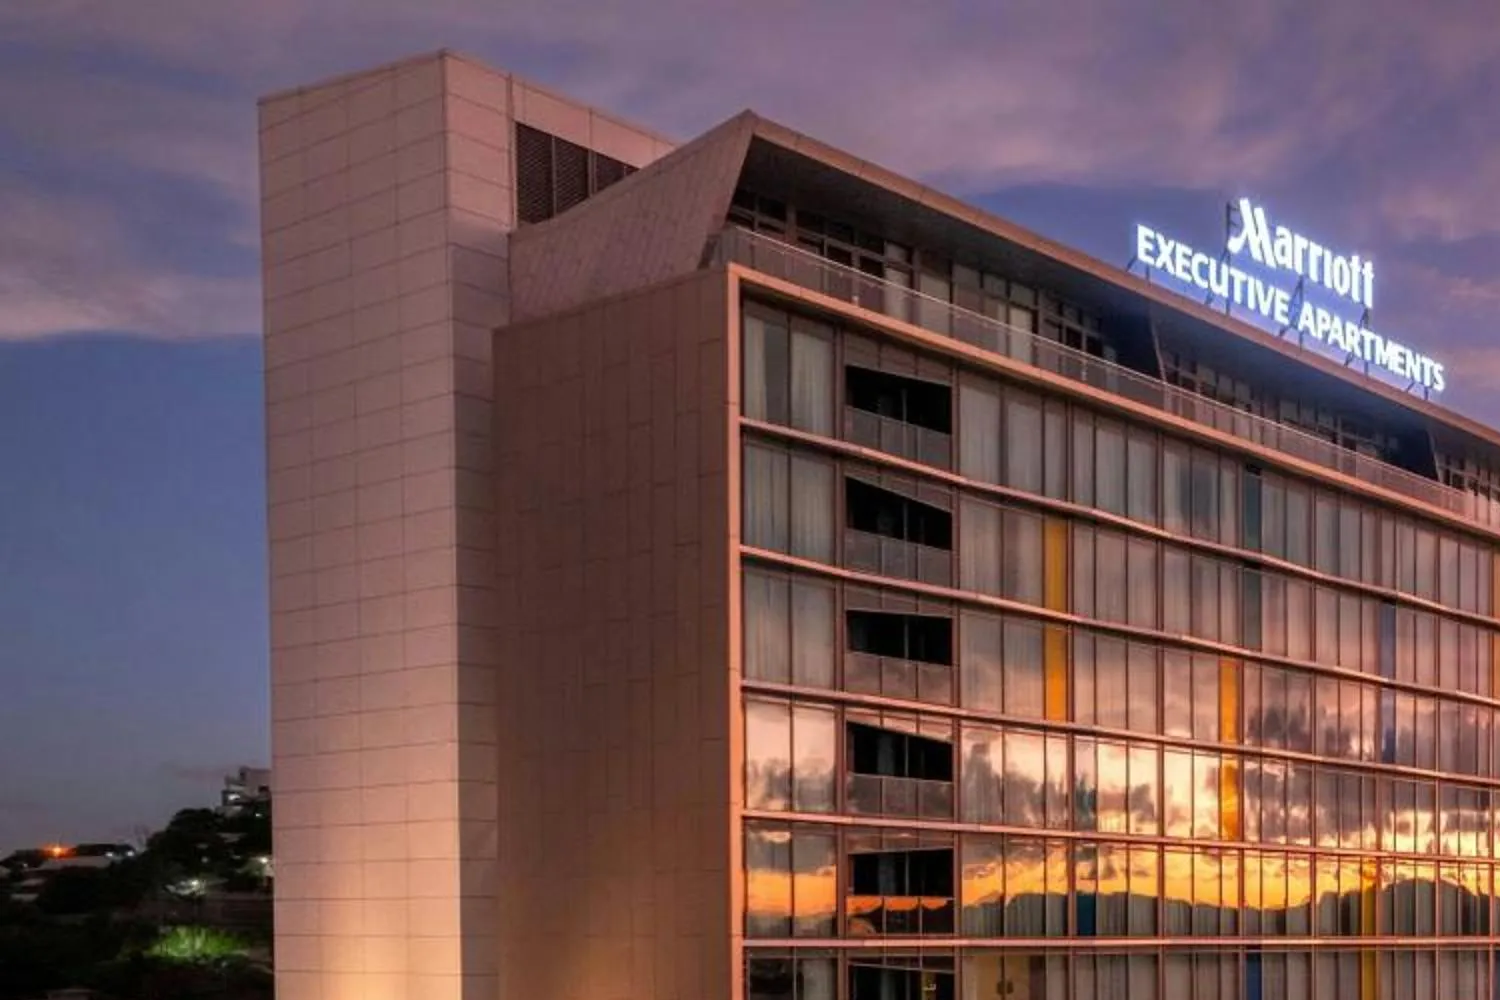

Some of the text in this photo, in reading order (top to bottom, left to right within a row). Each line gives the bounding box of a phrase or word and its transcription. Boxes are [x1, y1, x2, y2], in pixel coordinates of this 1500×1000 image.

[1137, 223, 1445, 392] EXECUTIVE APARTMENTS
[1228, 198, 1374, 309] Marriott
